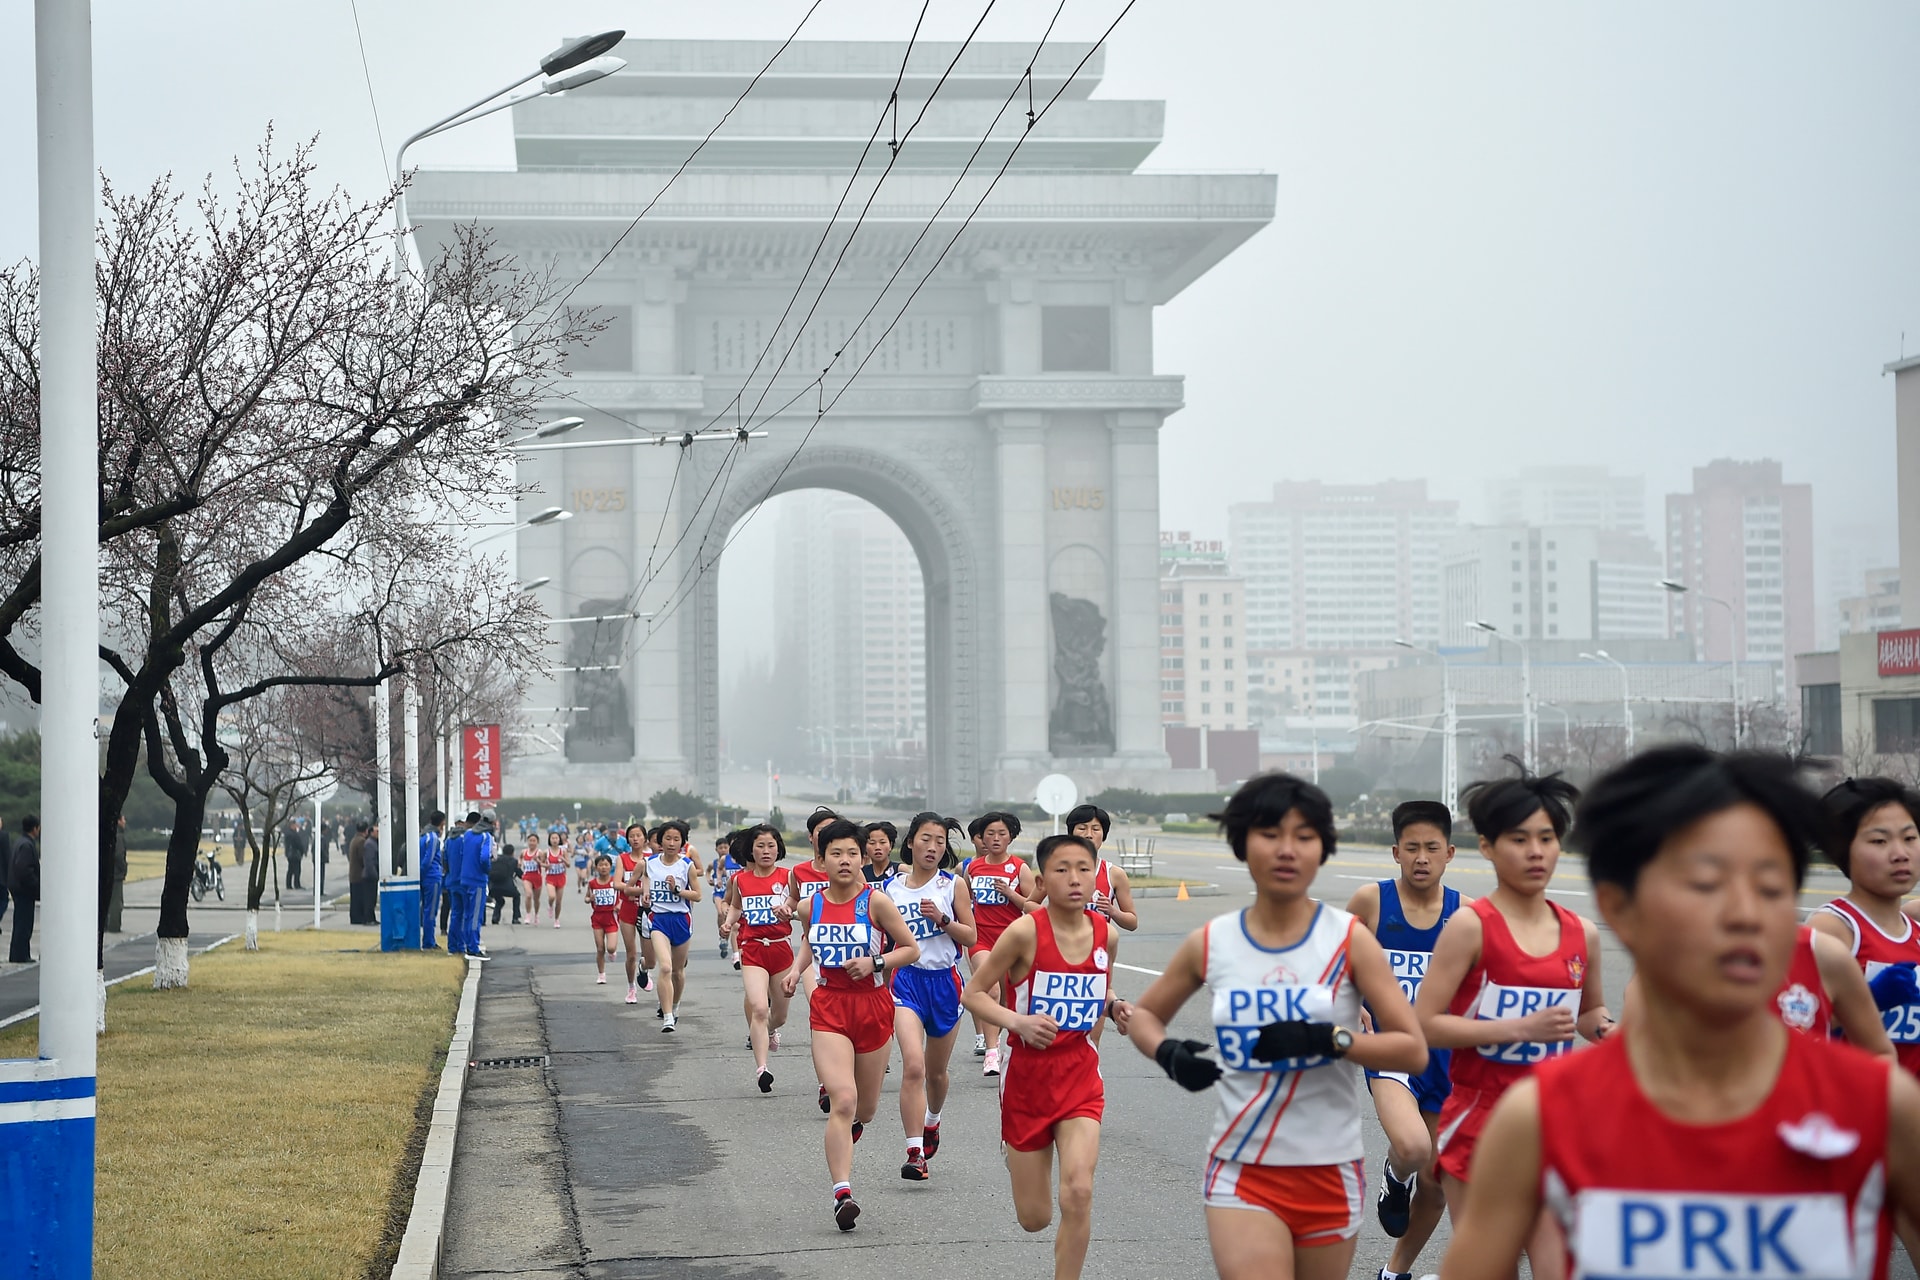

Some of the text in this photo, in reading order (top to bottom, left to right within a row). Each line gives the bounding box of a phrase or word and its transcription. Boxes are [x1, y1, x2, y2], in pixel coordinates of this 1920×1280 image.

[573, 488, 624, 511] 1925
[1053, 487, 1104, 510] 1945
[654, 881, 671, 890] PR
[976, 877, 994, 888] PR
[650, 891, 680, 902] 3216
[746, 897, 773, 908] PRK
[816, 925, 857, 942] PRK
[812, 945, 865, 966] 3210
[1389, 952, 1432, 976] PR
[1046, 974, 1096, 997] PRK
[1035, 1000, 1099, 1028] 3054
[1230, 988, 1311, 1022] PRK
[1620, 1200, 1804, 1275] PRK
